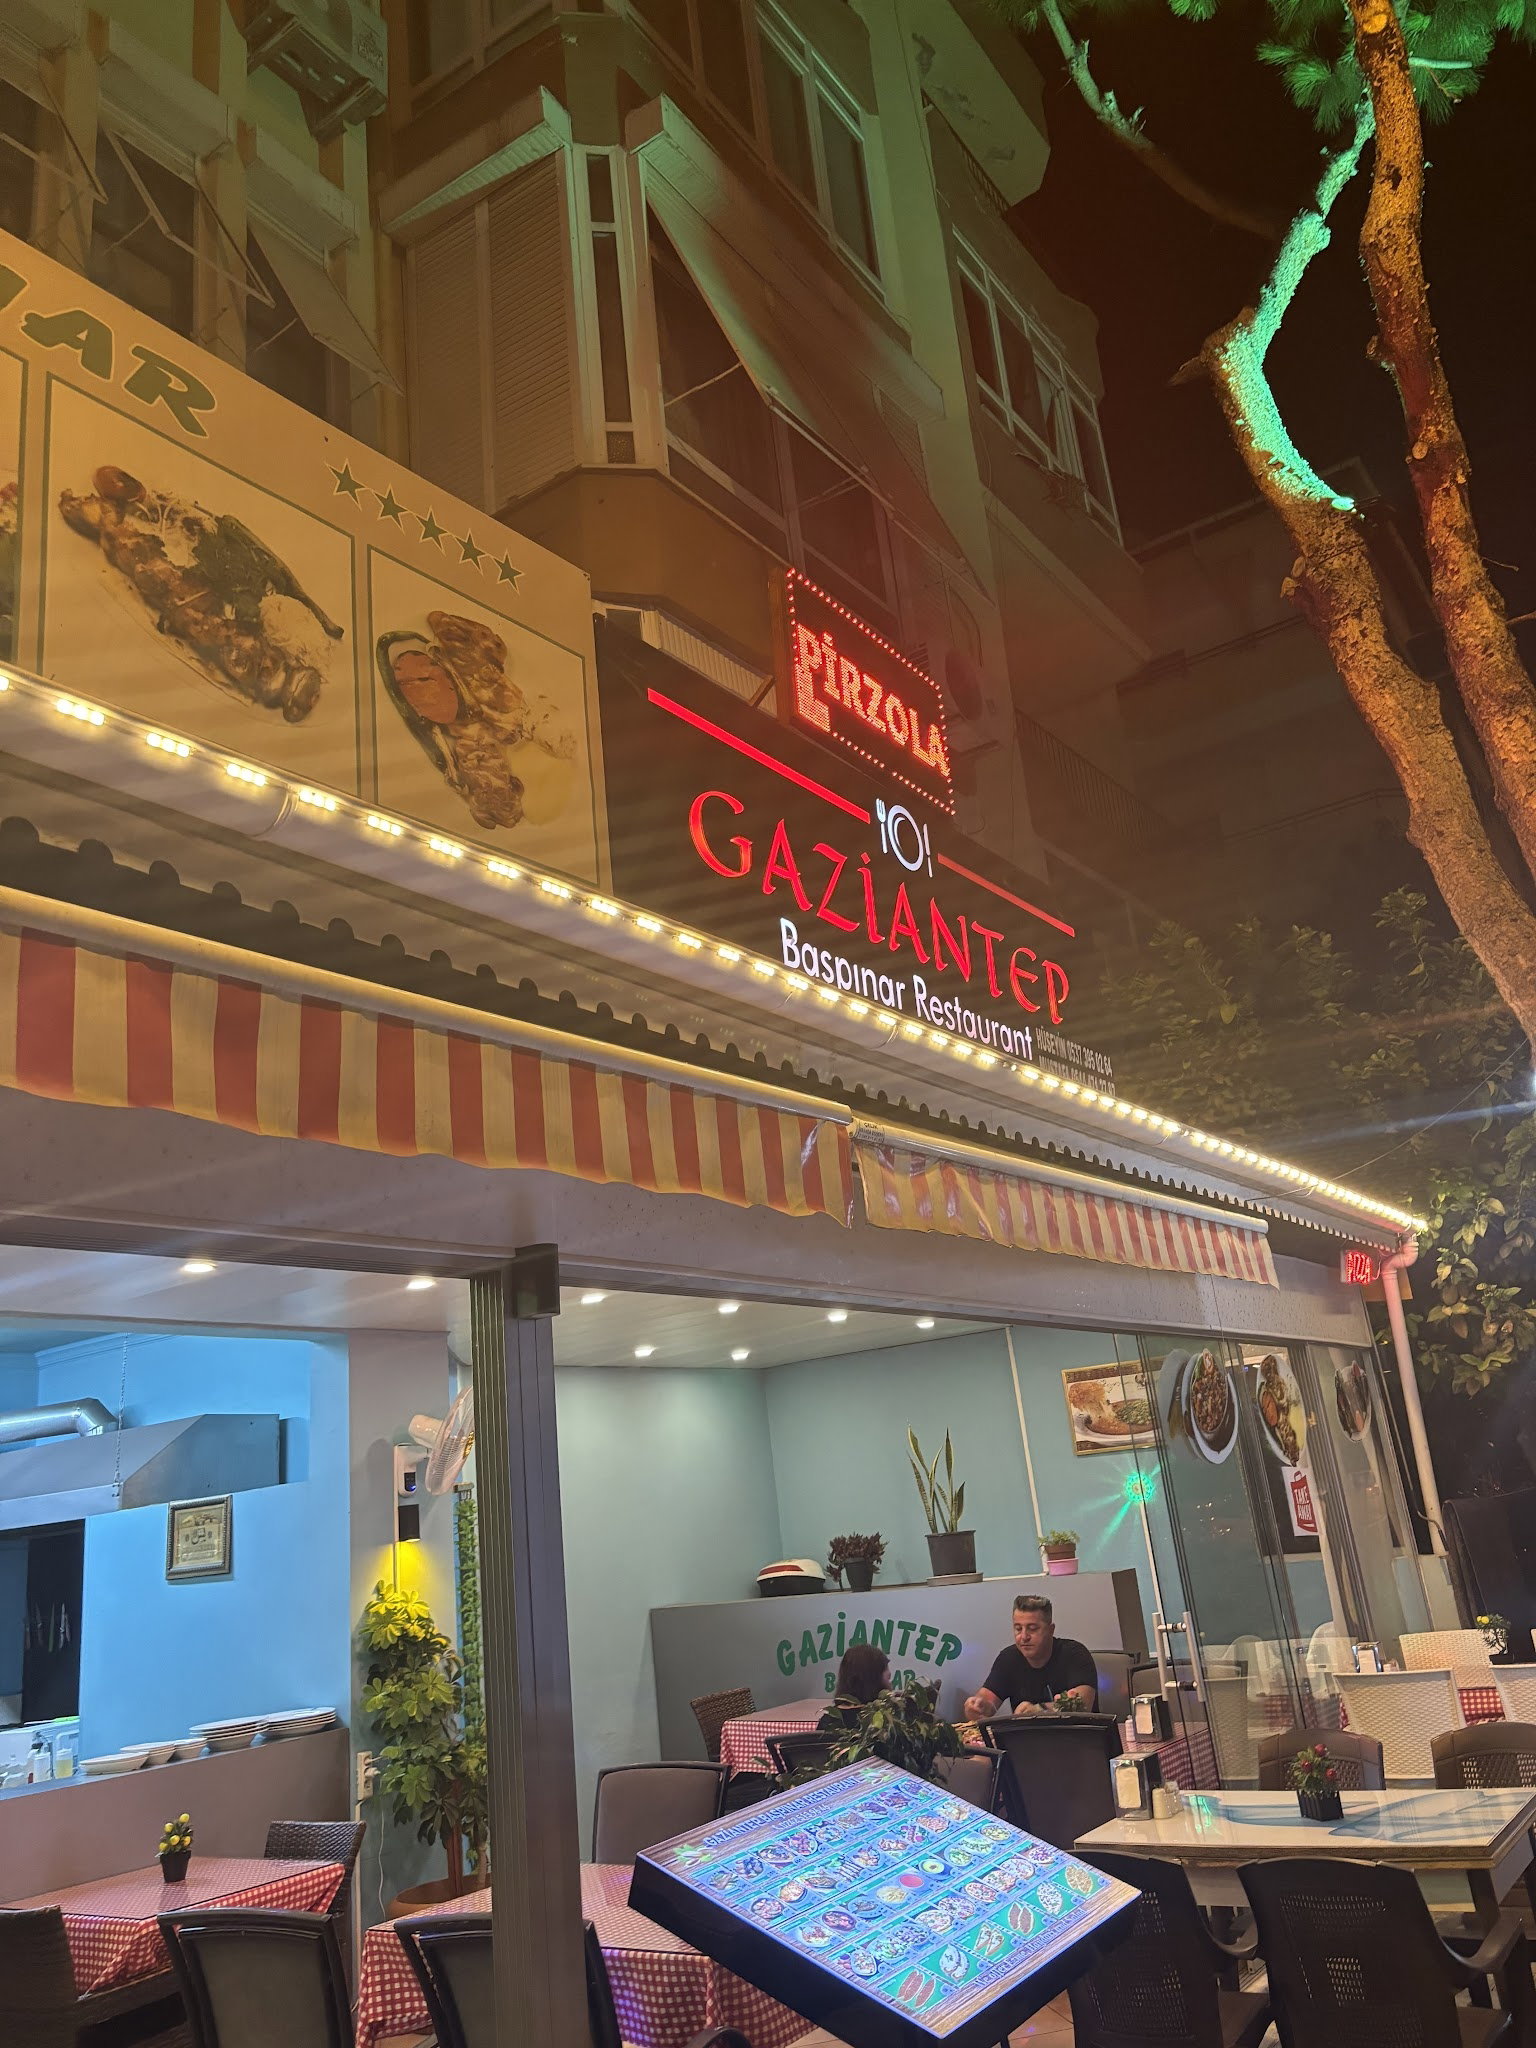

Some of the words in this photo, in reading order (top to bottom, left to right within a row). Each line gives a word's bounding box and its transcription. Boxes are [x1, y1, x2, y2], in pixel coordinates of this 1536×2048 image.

[0, 264, 216, 438] AR
[797, 623, 950, 776] PİRZOLA
[689, 790, 1069, 1024] GAZİANTEP
[912, 974, 1033, 1061] Restaurant
[1294, 1486, 1310, 1504] TAKE
[1297, 1503, 1313, 1520] AWAY
[776, 1611, 963, 1676] GAZİANTEP
[806, 1776, 861, 1804] RESTAURANT
